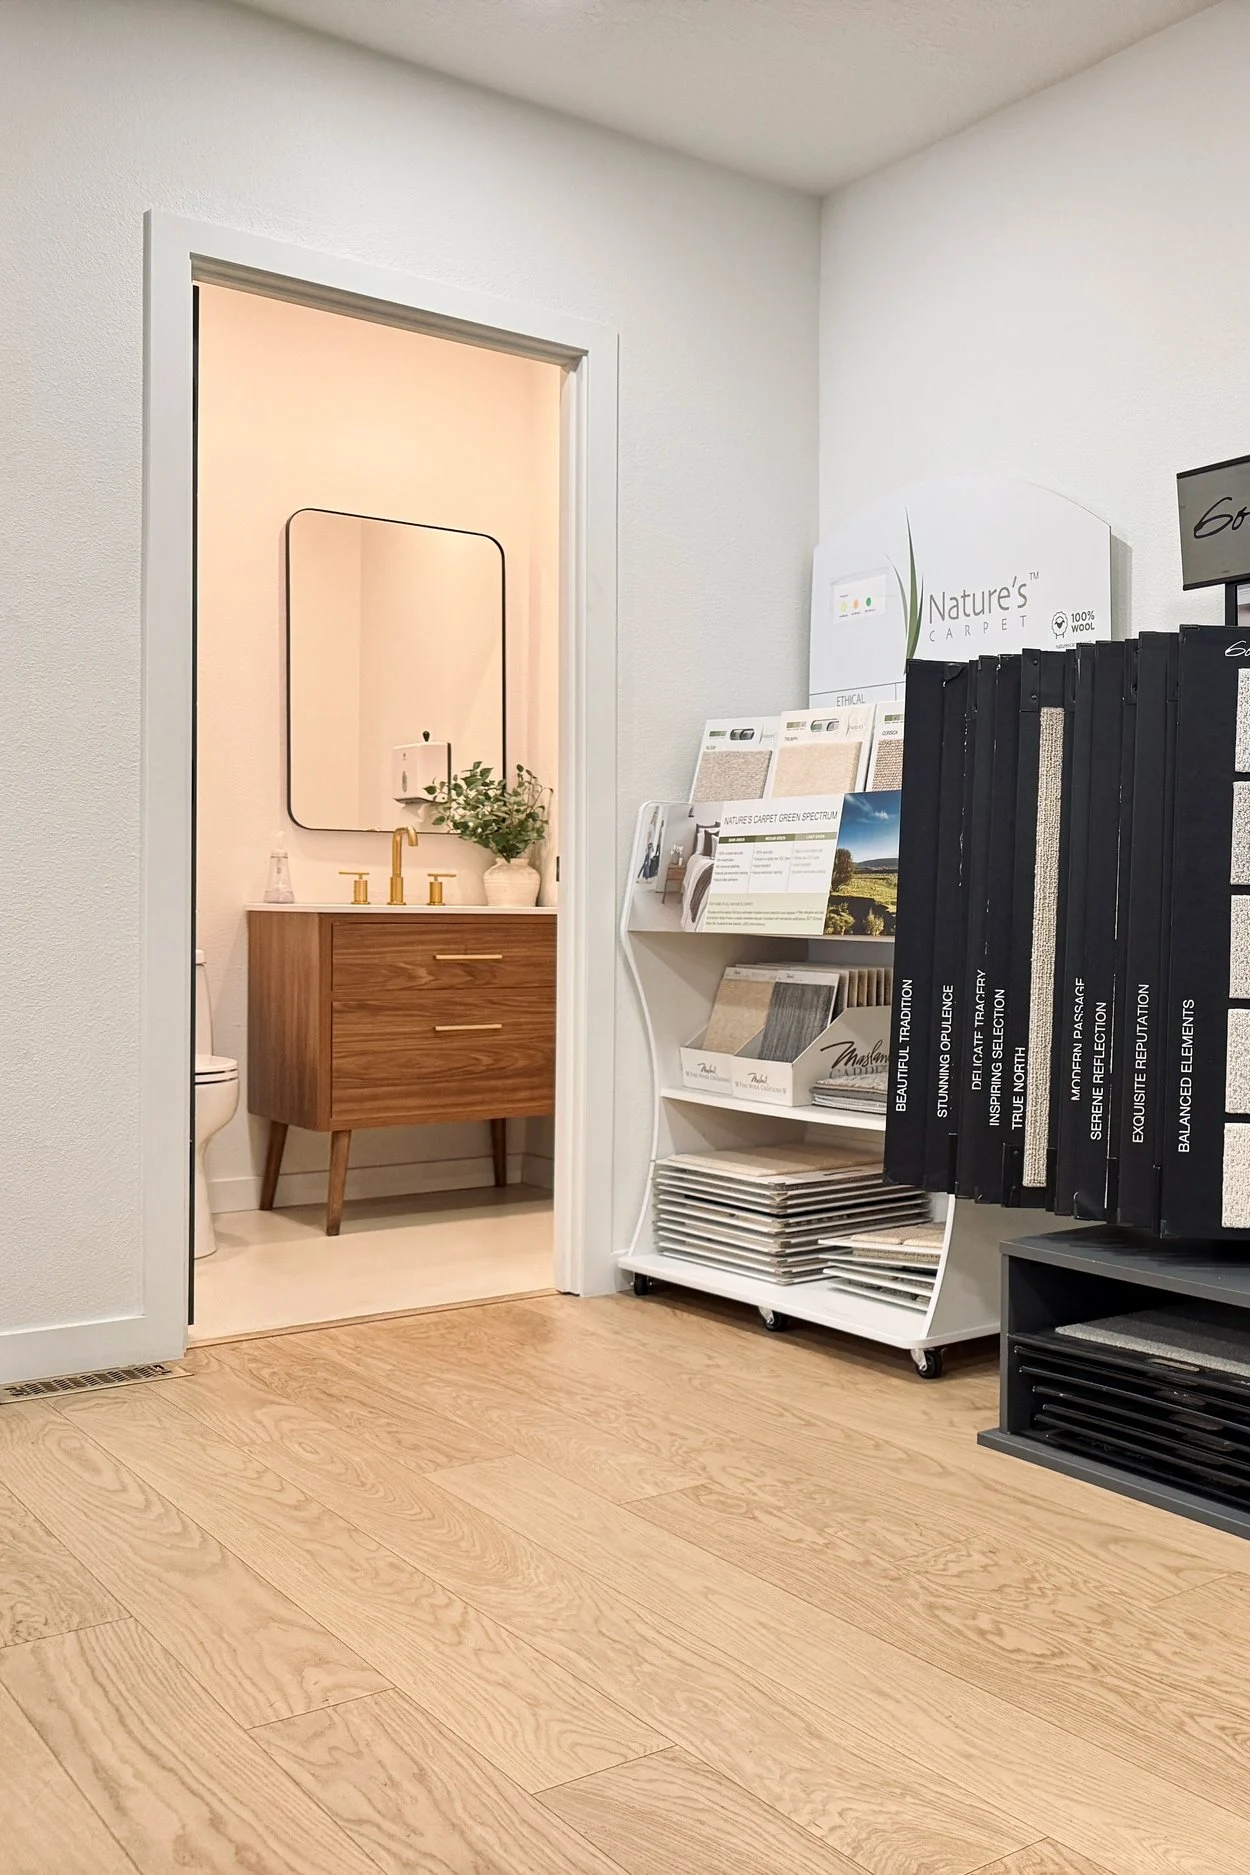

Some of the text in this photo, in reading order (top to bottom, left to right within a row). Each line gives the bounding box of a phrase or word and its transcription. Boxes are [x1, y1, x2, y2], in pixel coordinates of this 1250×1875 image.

[929, 576, 1027, 624] Nature's
[929, 615, 1027, 642] CARPET
[1071, 611, 1095, 623] 100%
[1071, 622, 1095, 633] WOOL
[836, 694, 865, 707] ETHICAL
[724, 811, 838, 825] NATURE'S CARPET GREEN SPECTRUM
[896, 980, 913, 1112] BEAUTIFUL TRADITION
[937, 985, 954, 1118] STUNNING OPULENCE
[989, 989, 1005, 1126] INSPIRING SELECTION
[1090, 1002, 1107, 1140] SERENE REFLECTION
[1132, 984, 1150, 1143] EXQUISITE REPUTATION
[1178, 999, 1195, 1153] BALANCED ELEMENTS
[1011, 1047, 1026, 1130] TRUE NORTH
